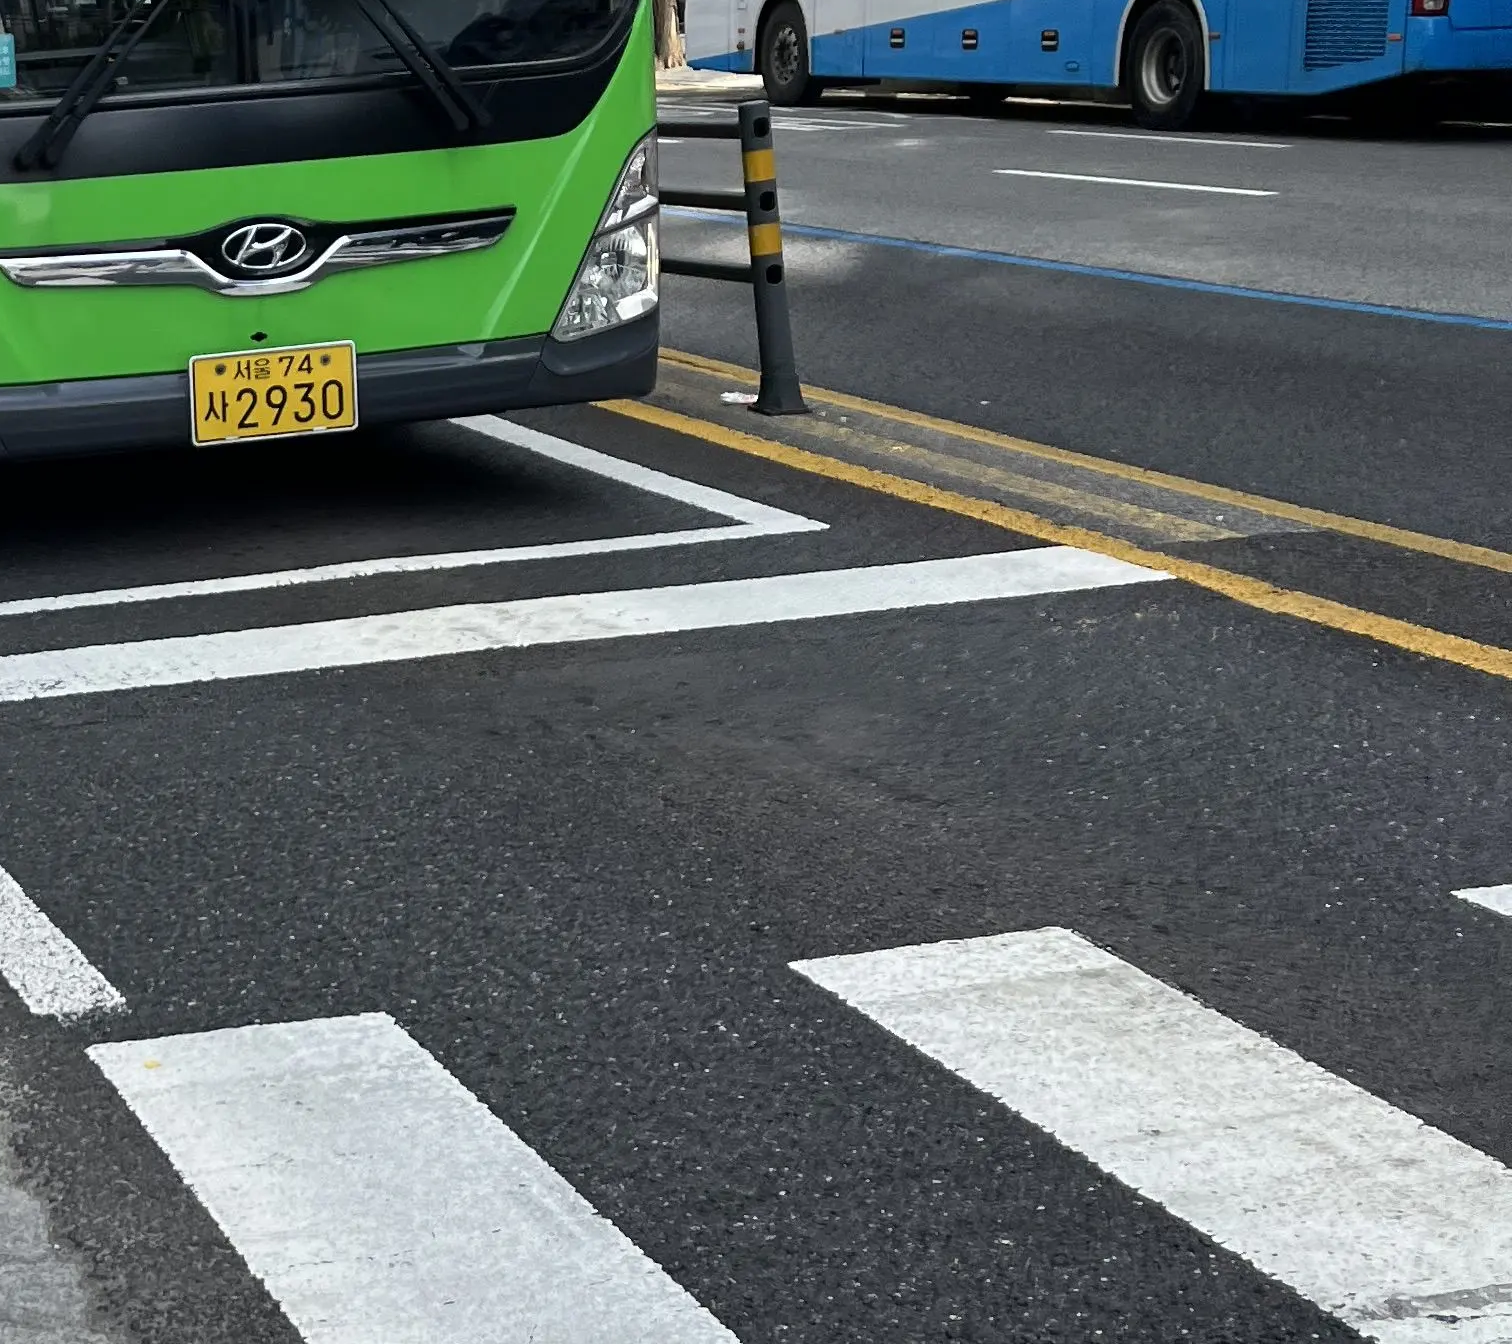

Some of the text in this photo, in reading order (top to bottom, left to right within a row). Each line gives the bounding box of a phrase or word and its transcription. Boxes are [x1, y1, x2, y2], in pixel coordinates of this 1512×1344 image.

[234, 353, 314, 380] 서울 74
[204, 379, 345, 429] 사 2930
